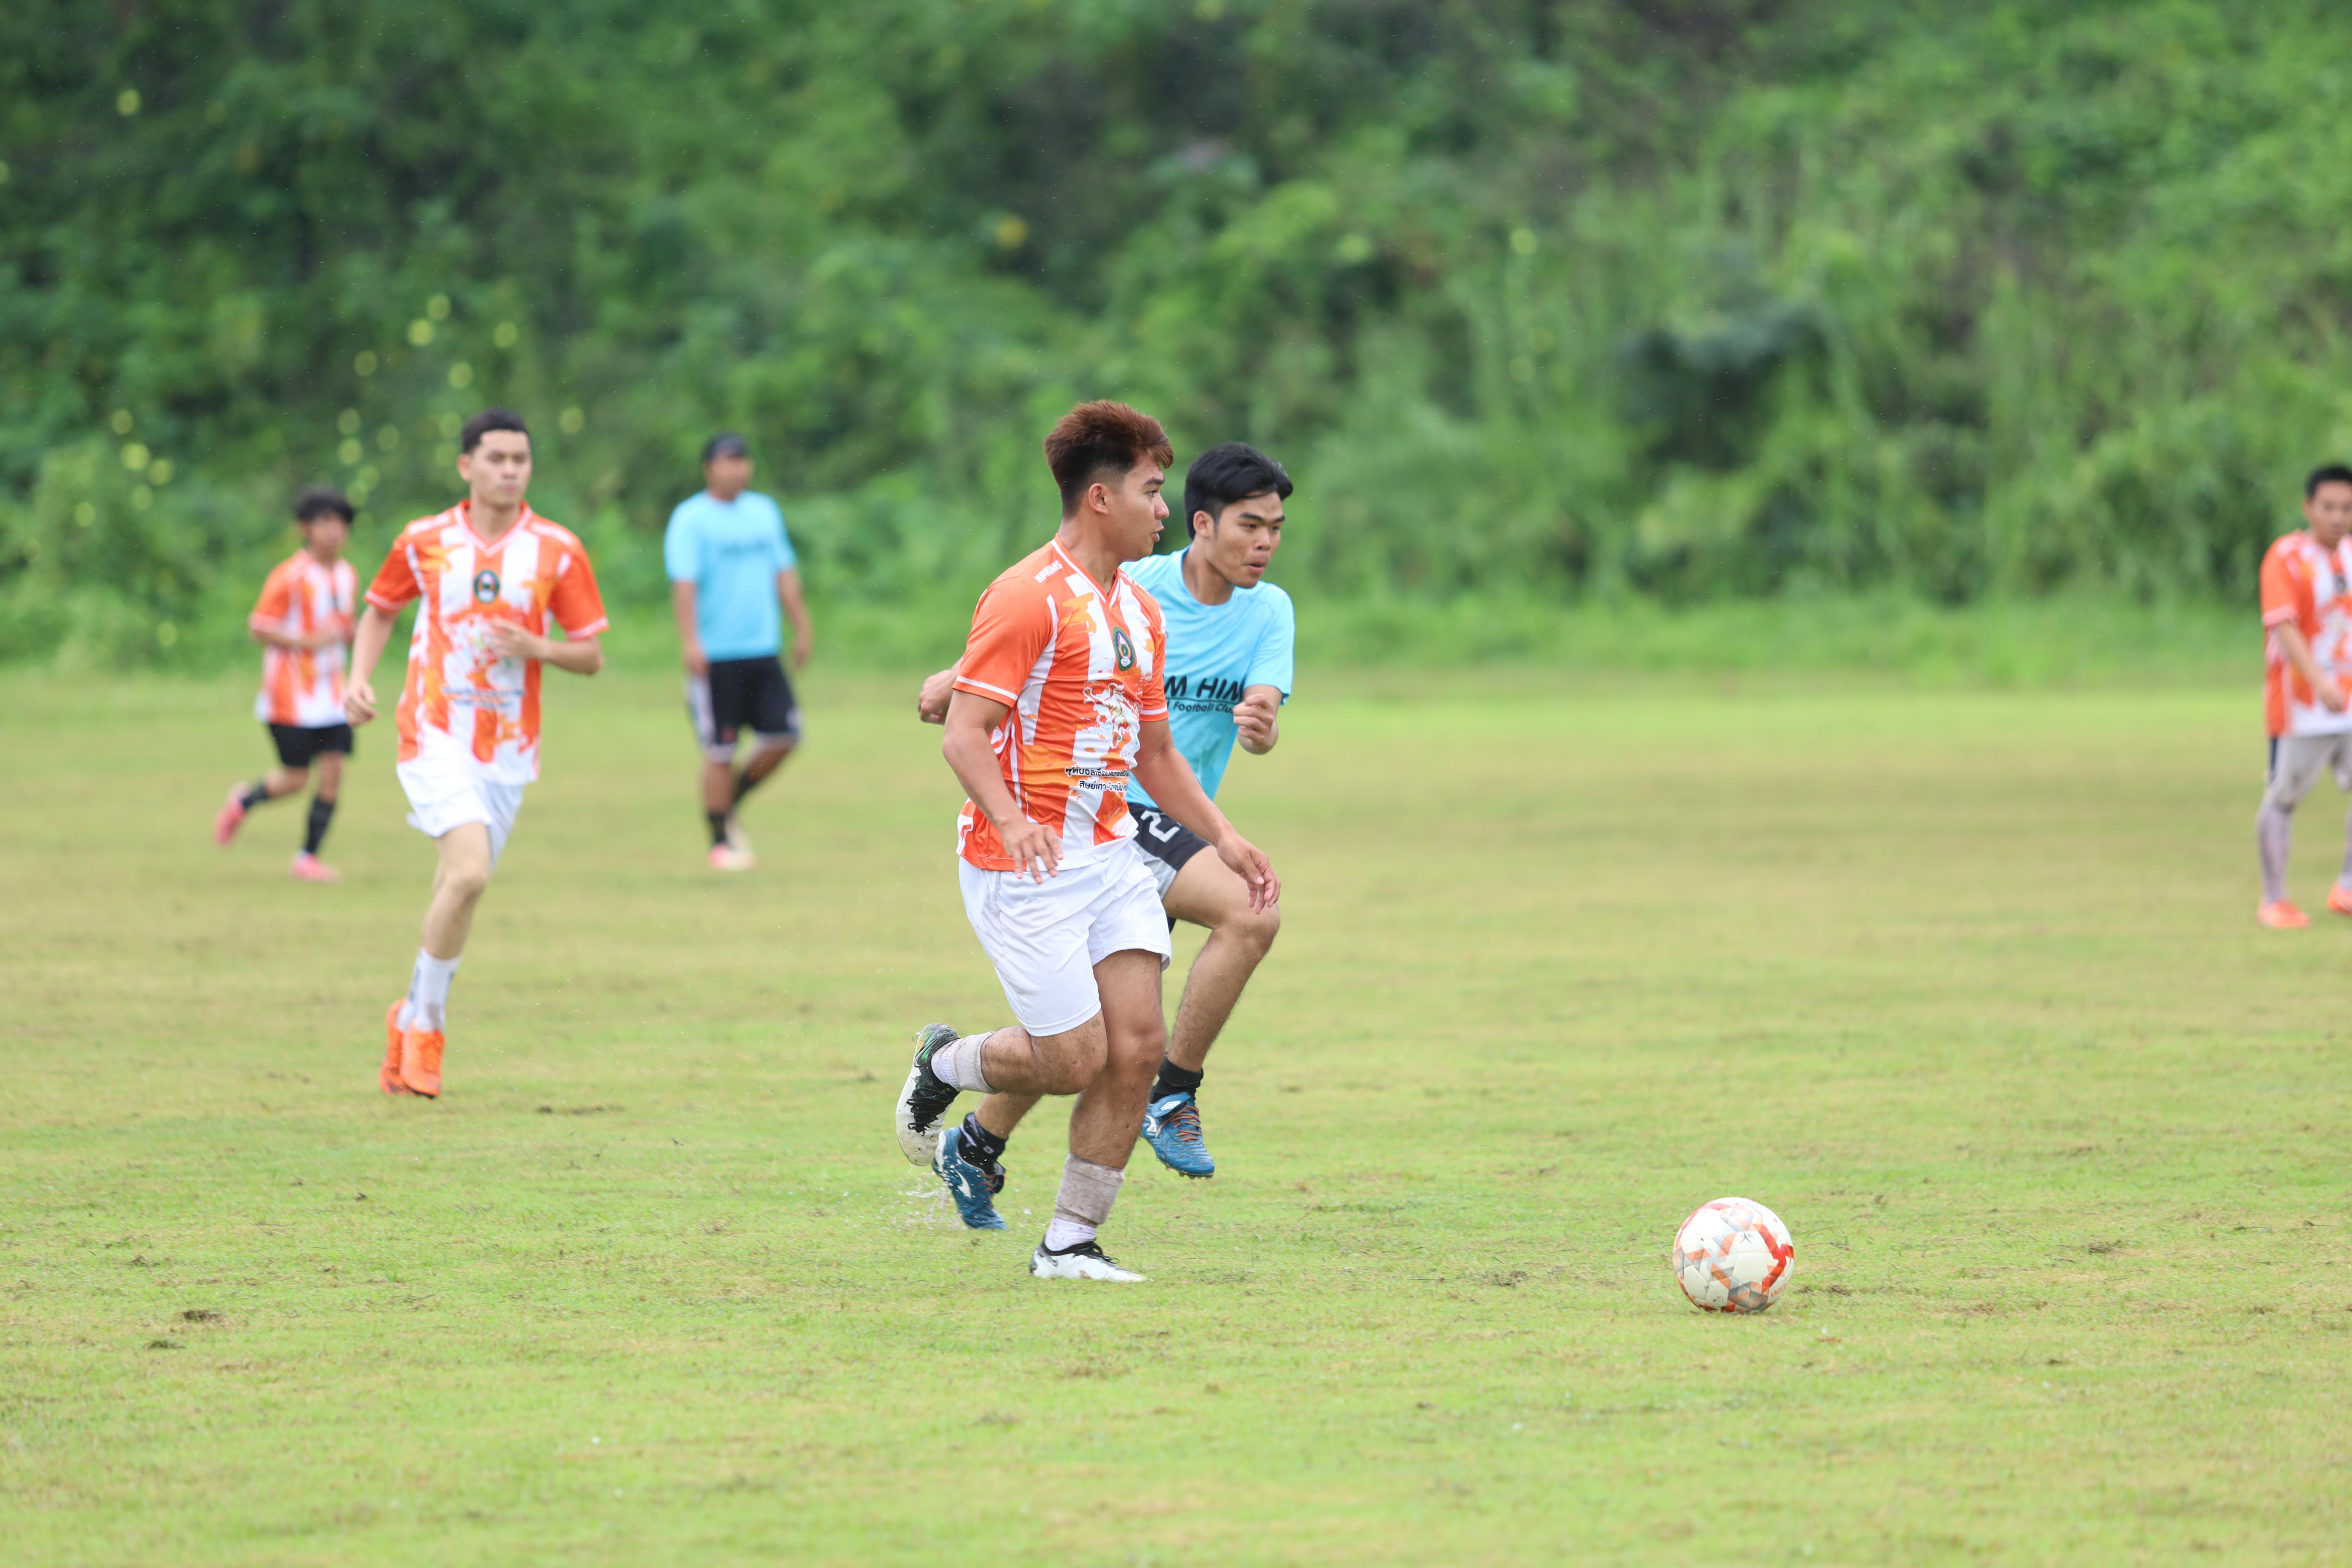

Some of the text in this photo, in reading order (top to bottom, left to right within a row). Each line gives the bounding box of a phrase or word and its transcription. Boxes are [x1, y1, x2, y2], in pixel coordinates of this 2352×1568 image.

[1163, 675, 1187, 697] M
[1173, 701, 1214, 713] Football
[1215, 703, 1234, 715] Clu
